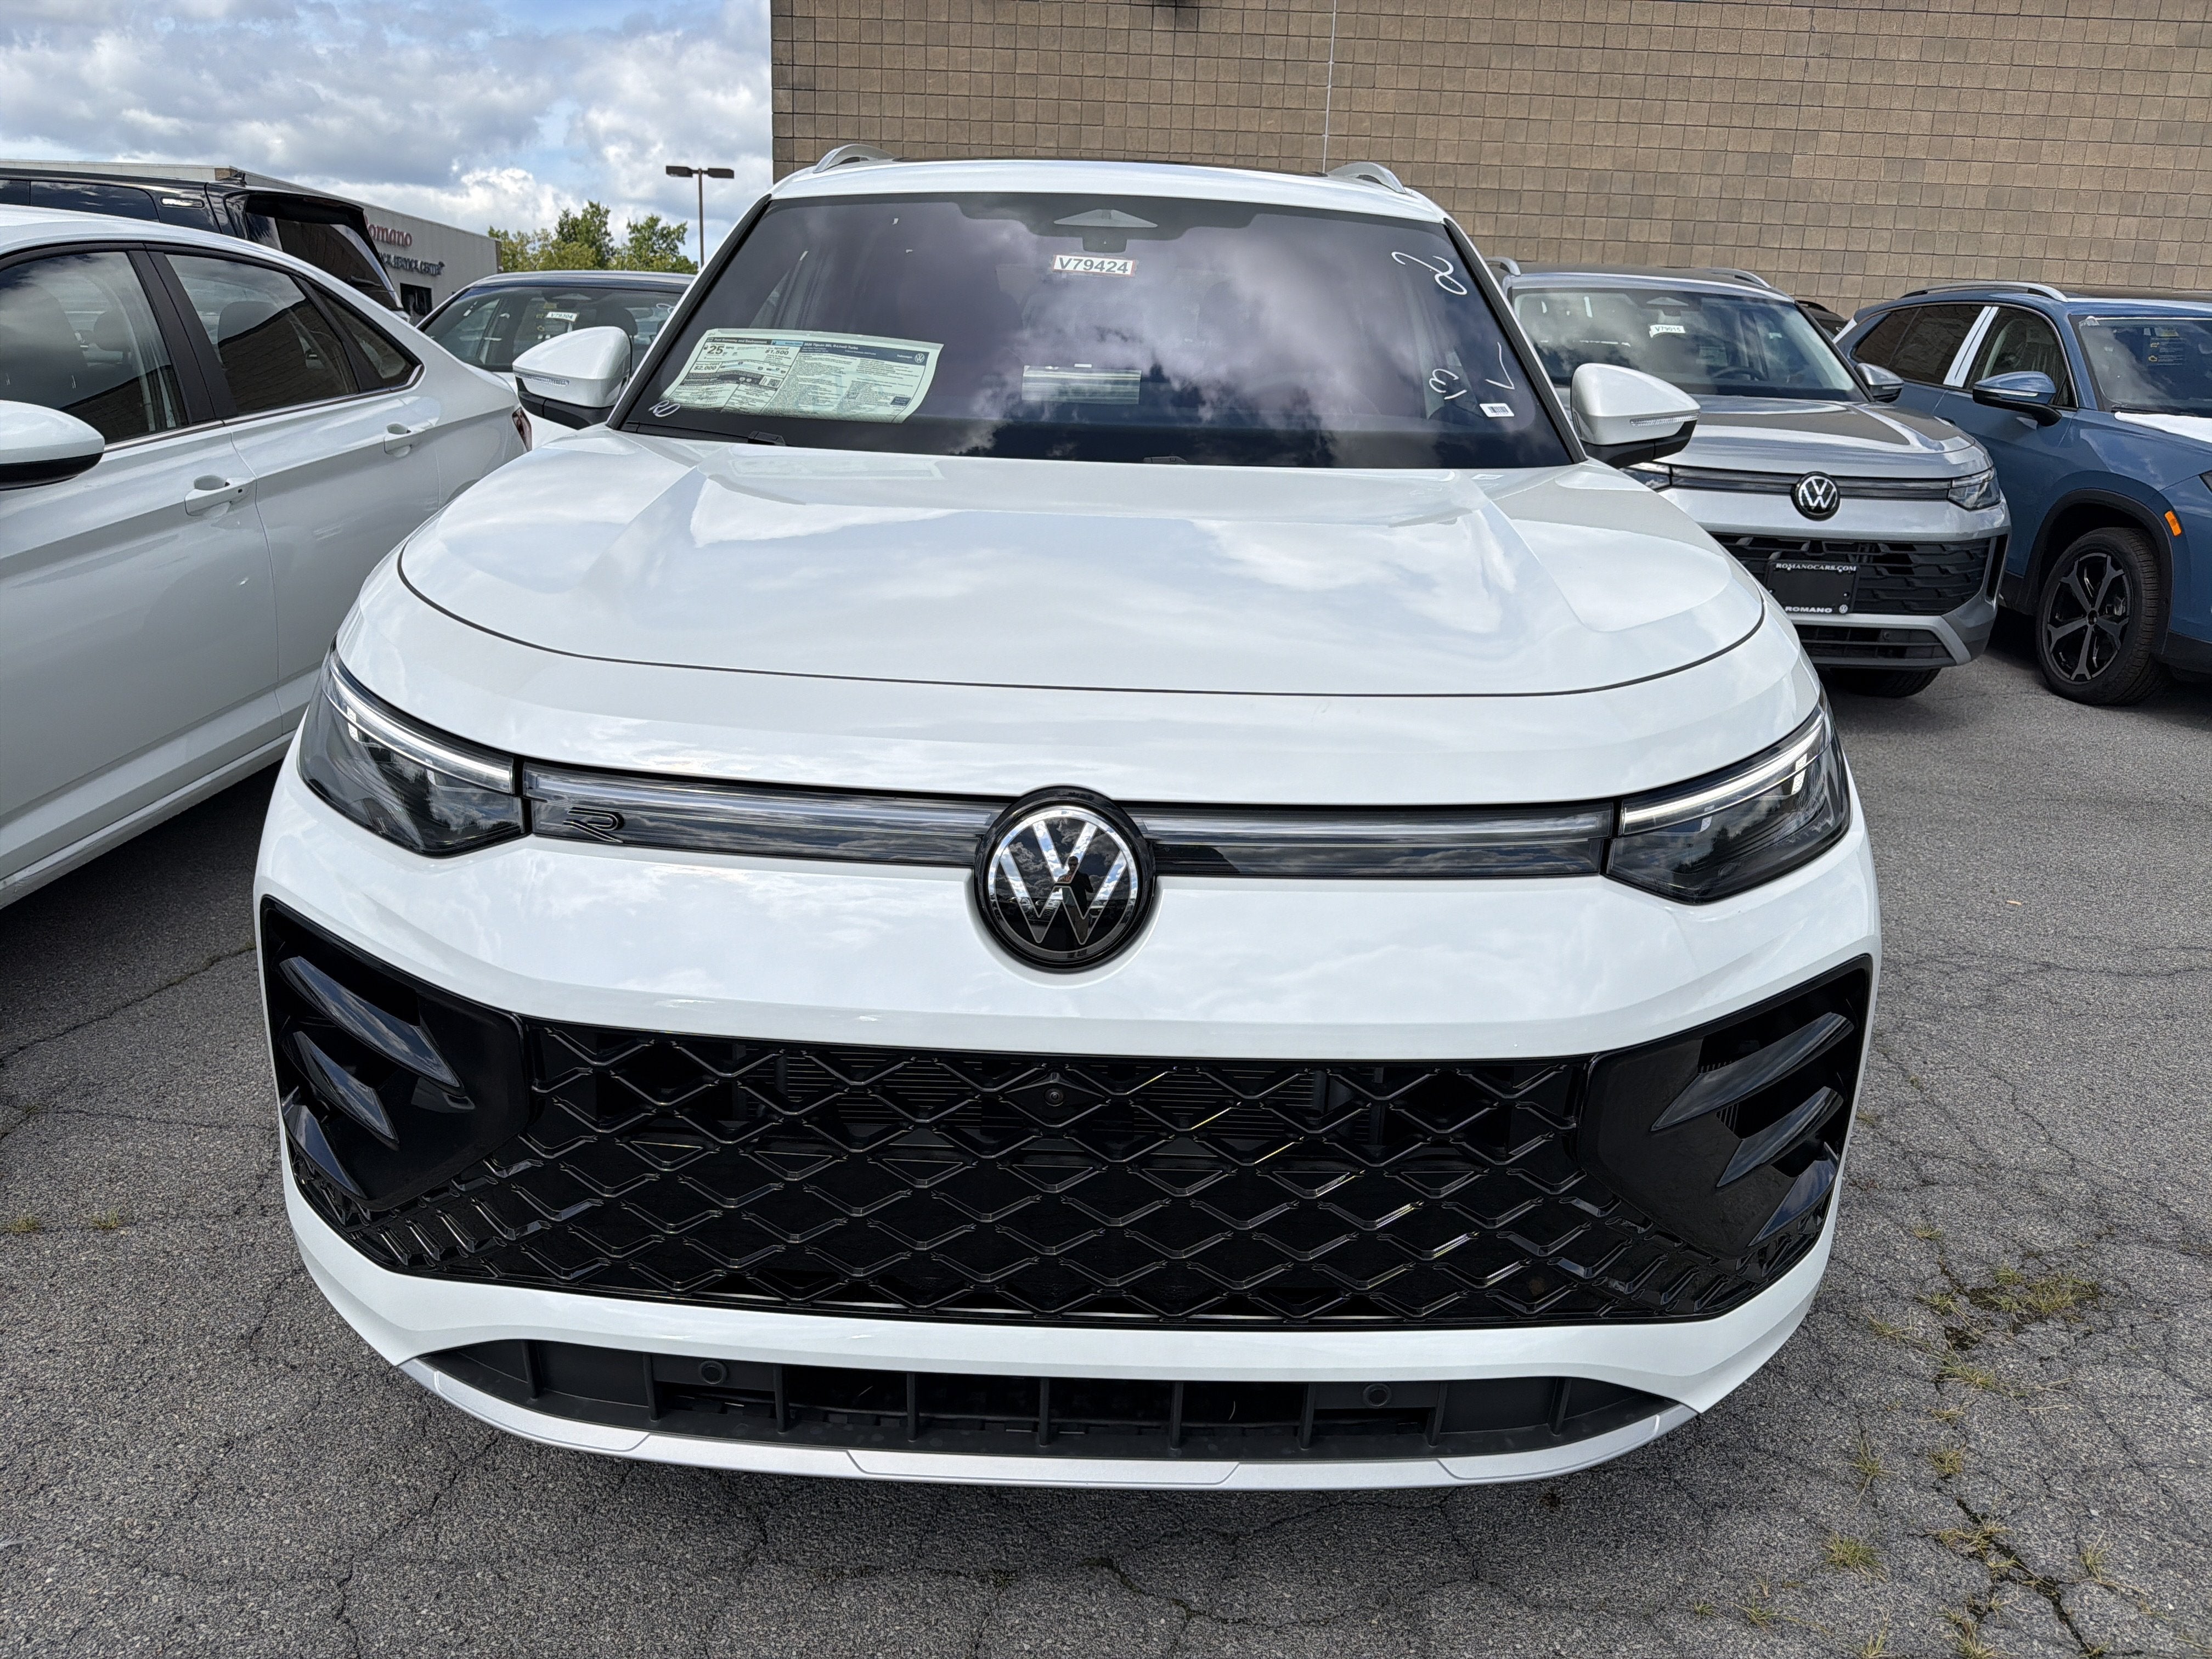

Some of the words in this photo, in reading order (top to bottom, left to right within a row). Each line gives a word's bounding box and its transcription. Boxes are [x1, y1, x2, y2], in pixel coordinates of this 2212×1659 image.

[364, 215, 413, 247] omano
[1059, 257, 1128, 274] V79424
[707, 345, 725, 354] 25
[1775, 563, 1857, 572] ROMANOCARS.COM
